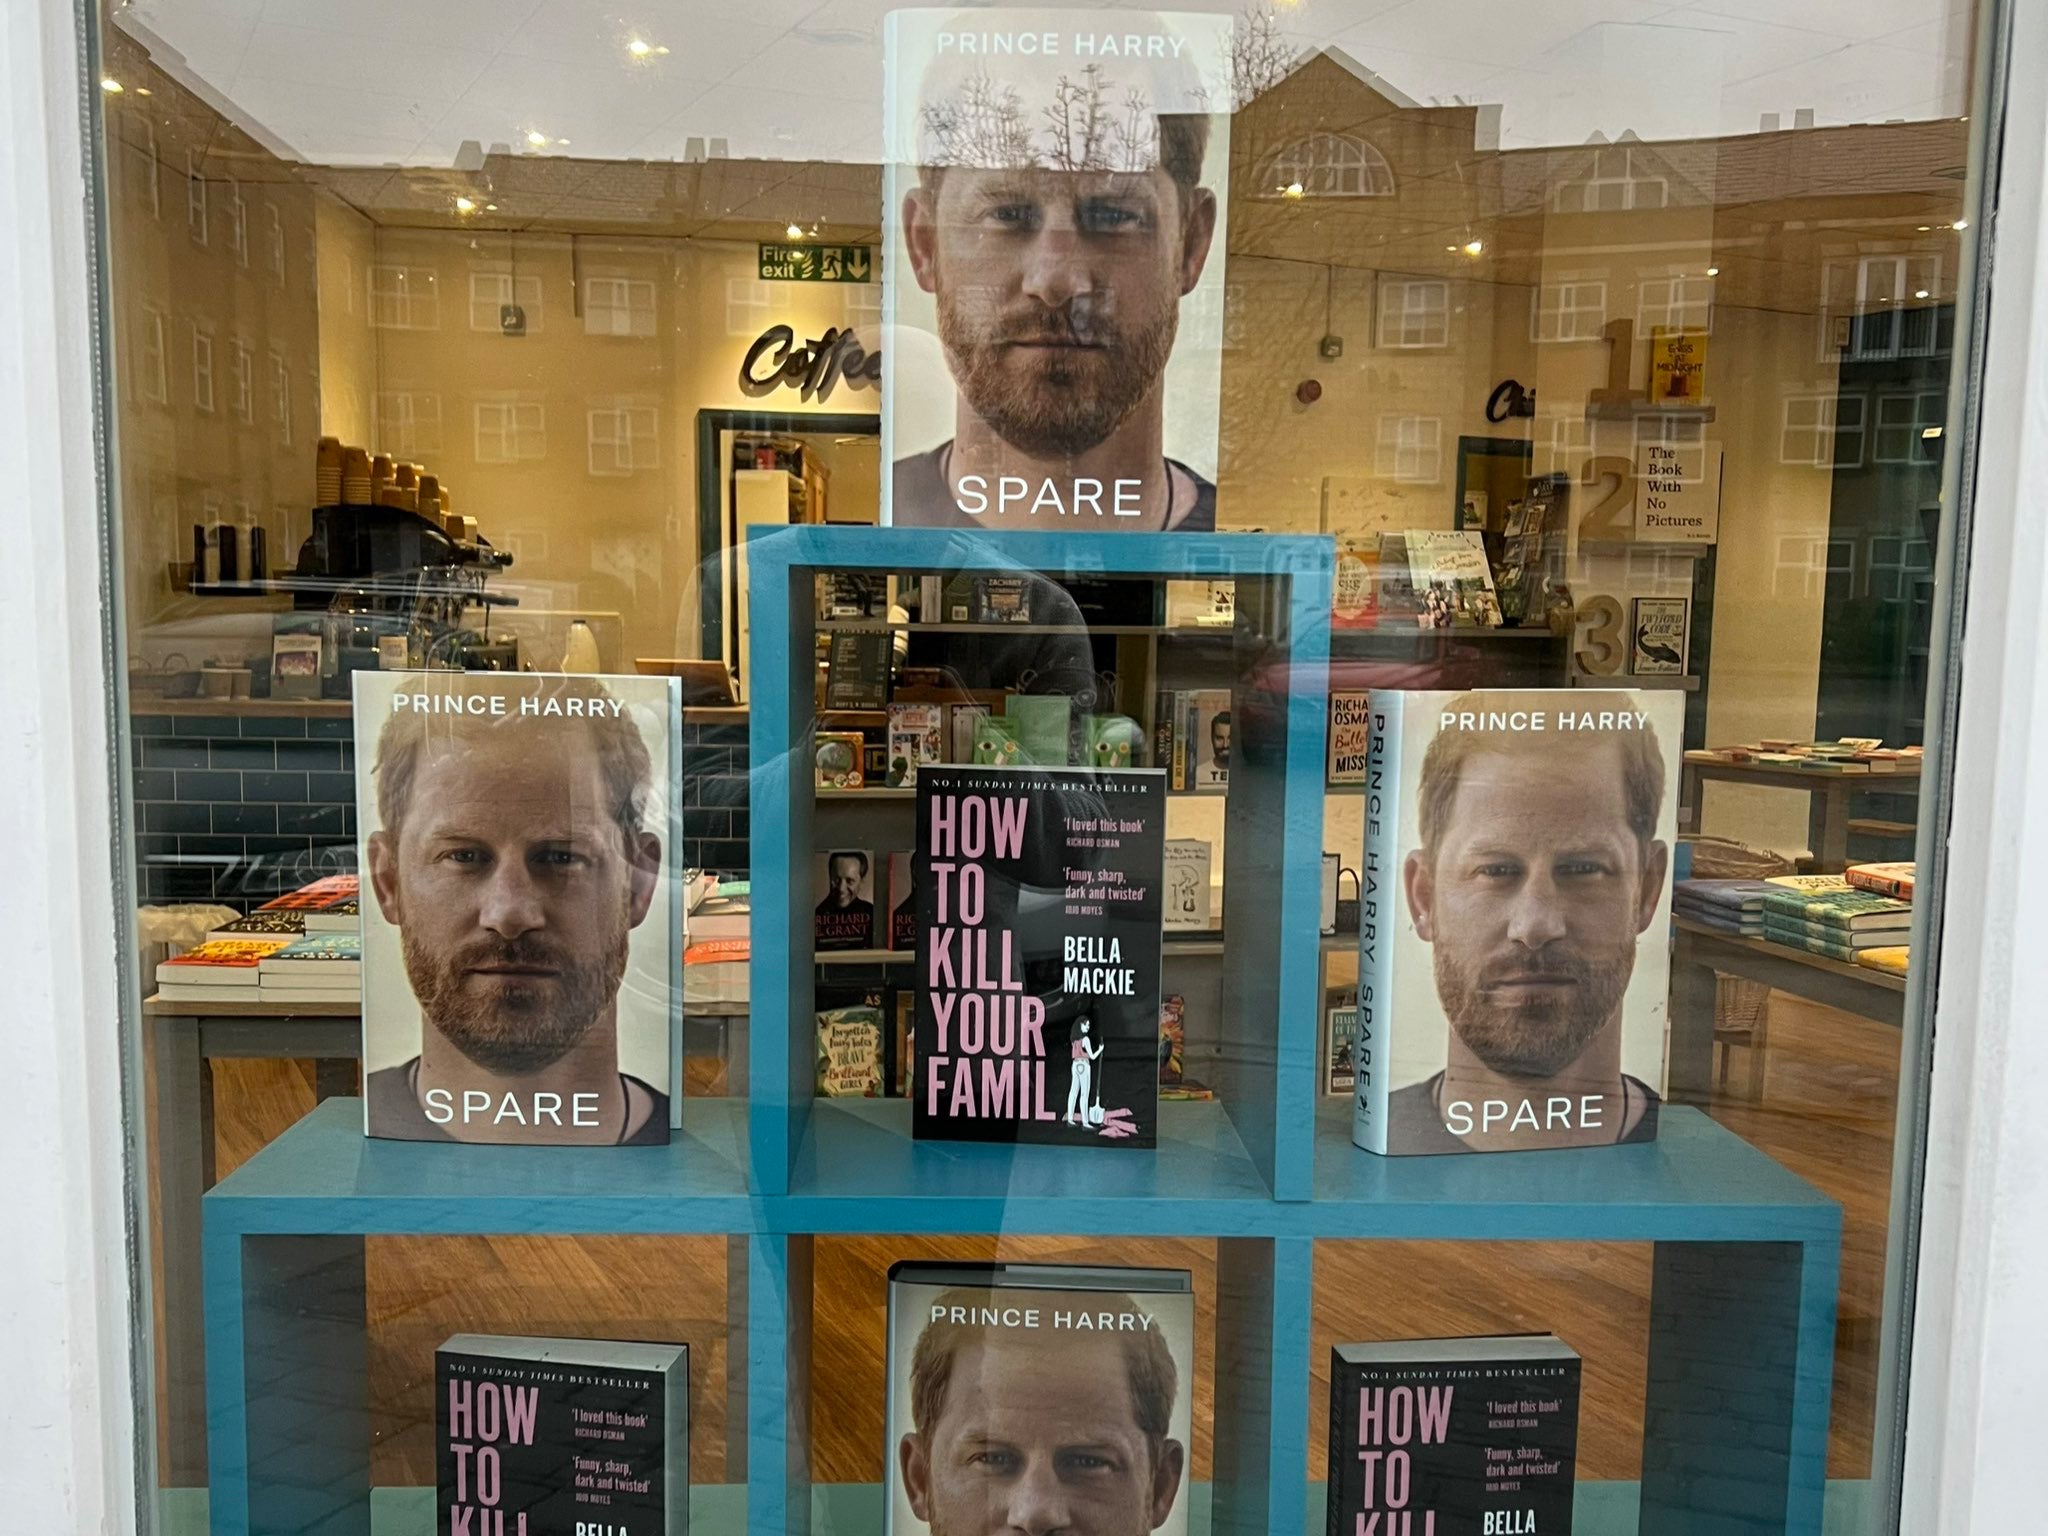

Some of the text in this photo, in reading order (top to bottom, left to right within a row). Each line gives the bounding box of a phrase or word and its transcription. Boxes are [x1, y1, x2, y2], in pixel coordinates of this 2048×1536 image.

[937, 32, 1186, 58] PRINCE HARRY
[762, 246, 797, 262] Fire
[762, 263, 795, 278] exit
[1649, 447, 1675, 458] The
[1649, 464, 1682, 475] Book
[956, 475, 1142, 516] SPARE
[1647, 481, 1681, 492] With
[1647, 498, 1666, 509] No
[1646, 515, 1702, 526] Pictures
[392, 693, 625, 718] PRINCE HARRY
[1334, 712, 1369, 725] OSMA
[1440, 711, 1649, 732] PRINCE HARRY
[932, 779, 1148, 793] NO.1 SUNDAY TIMES BESTSELLER
[1210, 771, 1227, 781] TE
[931, 795, 1028, 859] HOW
[1072, 818, 1097, 831] loved
[1100, 818, 1117, 832] this
[1098, 870, 1126, 885] sharp,
[931, 863, 984, 925] TO
[1065, 886, 1085, 899] dark
[1089, 887, 1105, 900] and
[1360, 714, 1385, 1088] PRINCE HARRY SPARE
[826, 925, 867, 936] GRANT
[930, 927, 1023, 991] KILL
[1064, 936, 1121, 963] BELLA
[1064, 967, 1135, 995] MACKIE
[930, 992, 1046, 1056] YOUR
[424, 1088, 600, 1127] SPARE
[1445, 1095, 1604, 1135] SPARE
[931, 1305, 1154, 1331] PRINCE HARRY
[483, 1367, 524, 1378] SUNDAY
[570, 1376, 650, 1390] BESTSELLER
[1396, 1371, 1441, 1379] SUNDAY
[1446, 1370, 1480, 1378] TIMES
[1486, 1368, 1566, 1377] BESTSELLER
[449, 1379, 539, 1446] HOW
[1358, 1385, 1454, 1445] HOW
[1494, 1401, 1519, 1413] loved
[1520, 1400, 1537, 1412] this
[580, 1410, 604, 1424] loved
[606, 1413, 623, 1425] this
[450, 1443, 501, 1506] TO
[1358, 1450, 1410, 1509] TO
[1486, 1465, 1506, 1477] dark
[1508, 1464, 1524, 1475] and
[575, 1473, 595, 1488] dark
[597, 1476, 613, 1490] and
[1483, 1509, 1536, 1535] BELLA
